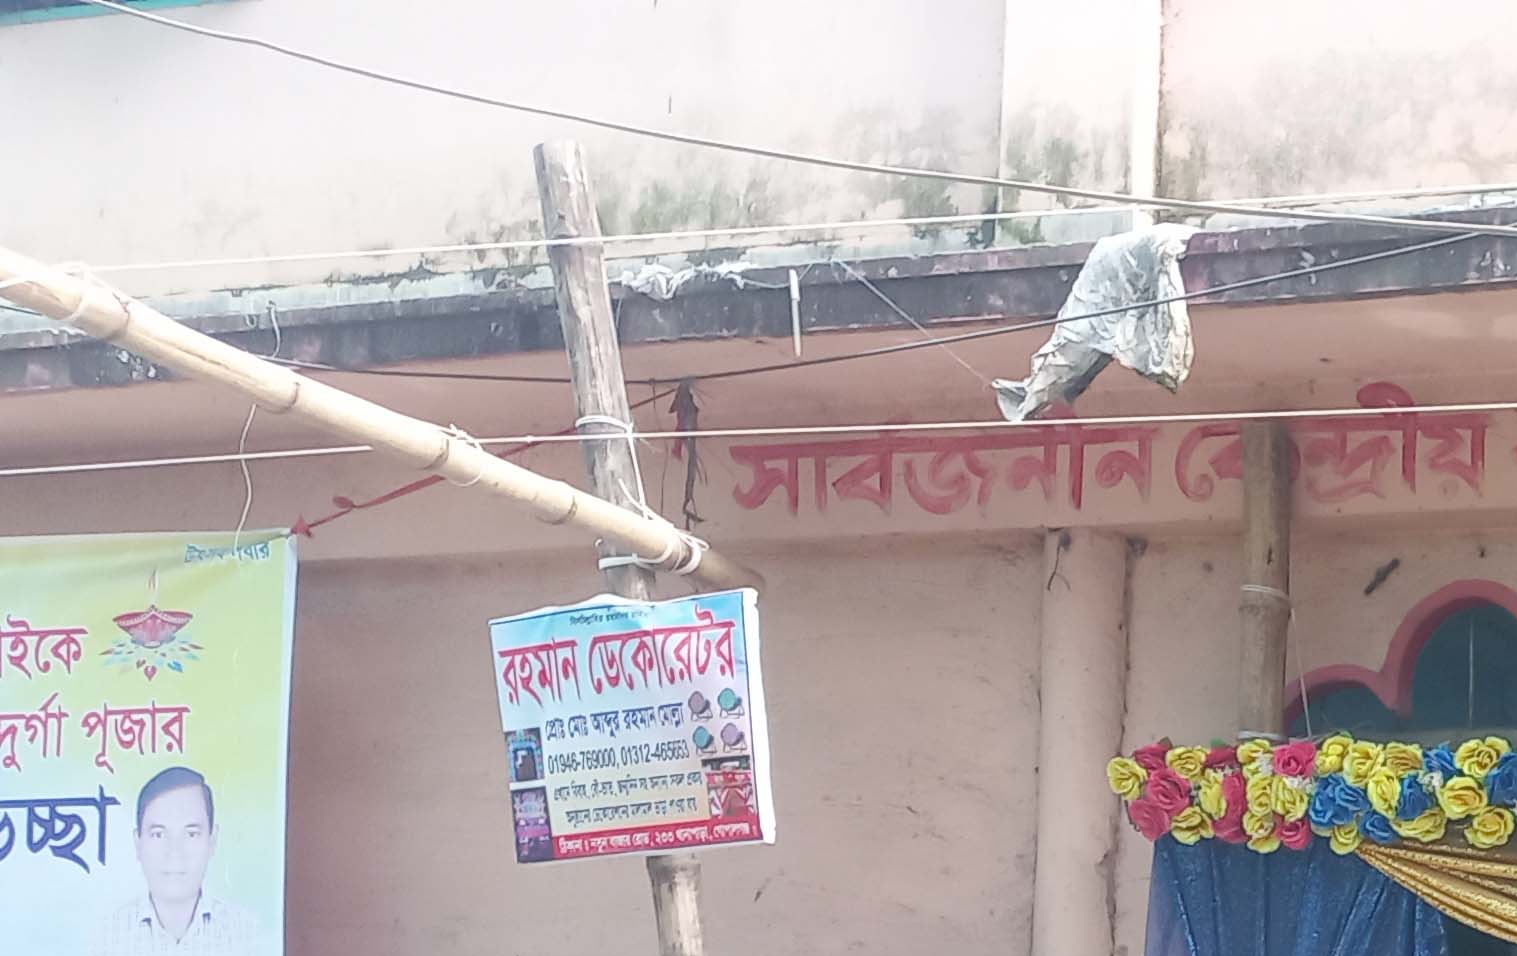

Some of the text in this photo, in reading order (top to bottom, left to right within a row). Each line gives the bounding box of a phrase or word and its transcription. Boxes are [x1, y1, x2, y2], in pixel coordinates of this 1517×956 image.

[498, 604, 737, 708] রহমান ডেকোরেটর
[81, 700, 191, 774] পূজার
